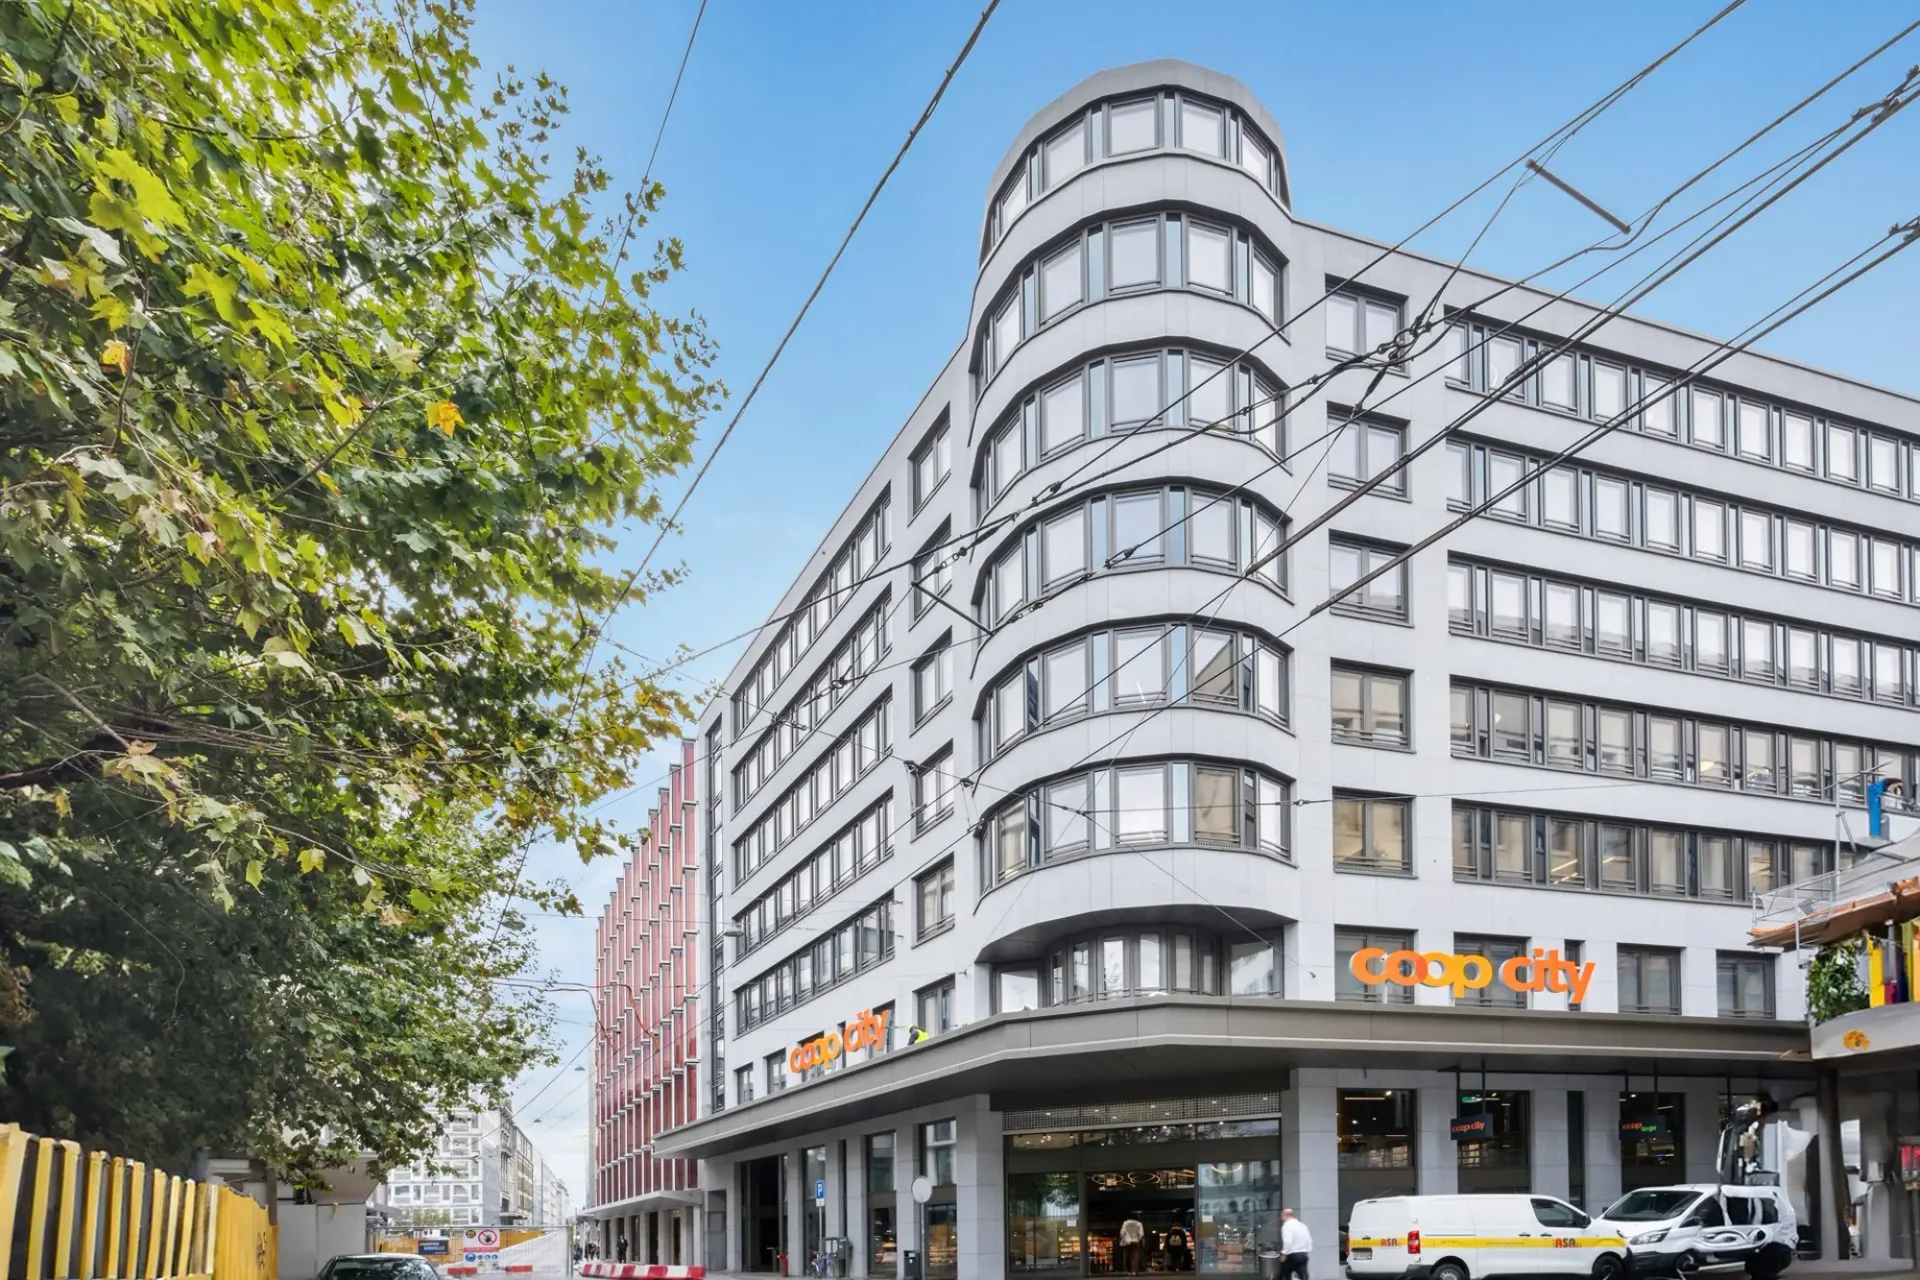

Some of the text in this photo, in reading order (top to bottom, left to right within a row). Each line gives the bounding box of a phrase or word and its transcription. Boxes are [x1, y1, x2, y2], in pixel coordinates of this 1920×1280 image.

[1350, 947, 1596, 1003] coop city
[789, 1008, 890, 1074] coop city
[1451, 1120, 1485, 1133] coop city
[1622, 1122, 1642, 1130] coop
[817, 1183, 823, 1198] P
